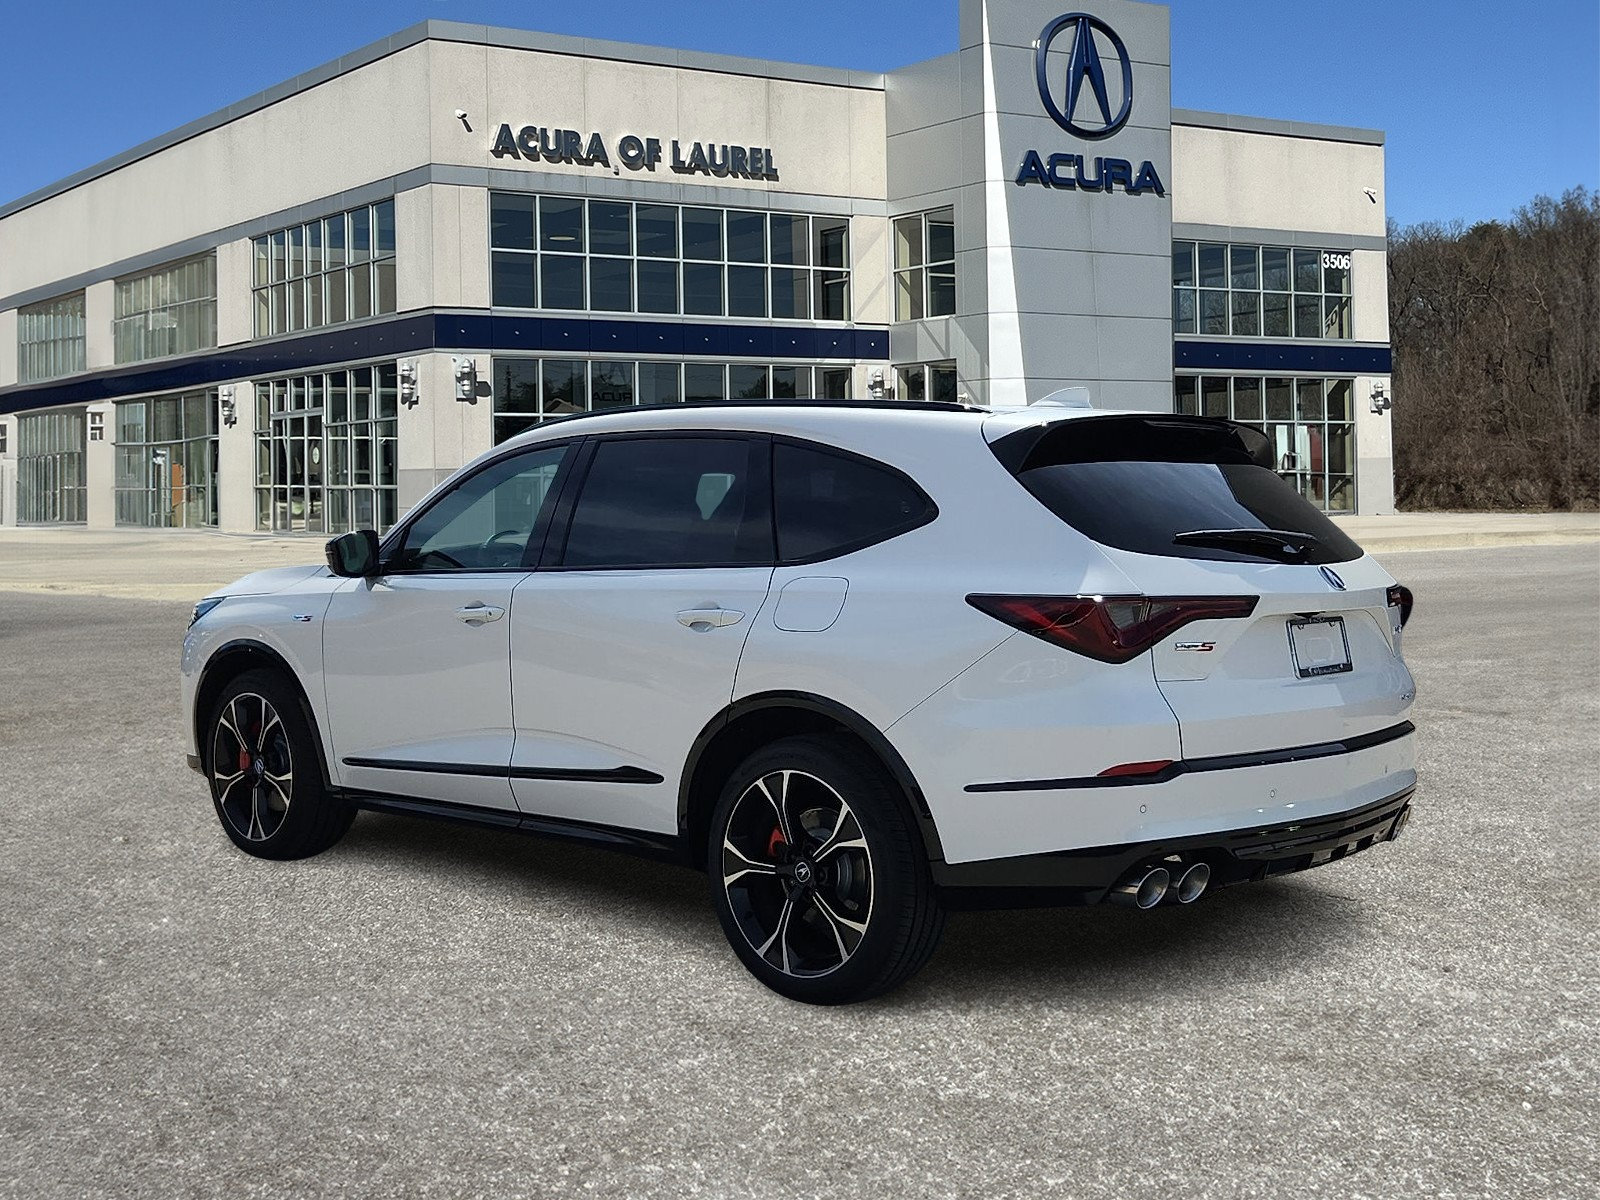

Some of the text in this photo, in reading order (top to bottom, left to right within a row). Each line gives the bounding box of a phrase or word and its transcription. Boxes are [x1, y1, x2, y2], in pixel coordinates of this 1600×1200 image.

[491, 123, 778, 181] ACURA OF LAUREL
[1016, 150, 1165, 197] ACURA
[1322, 253, 1350, 269] 3506
[593, 392, 632, 401] ACUR
